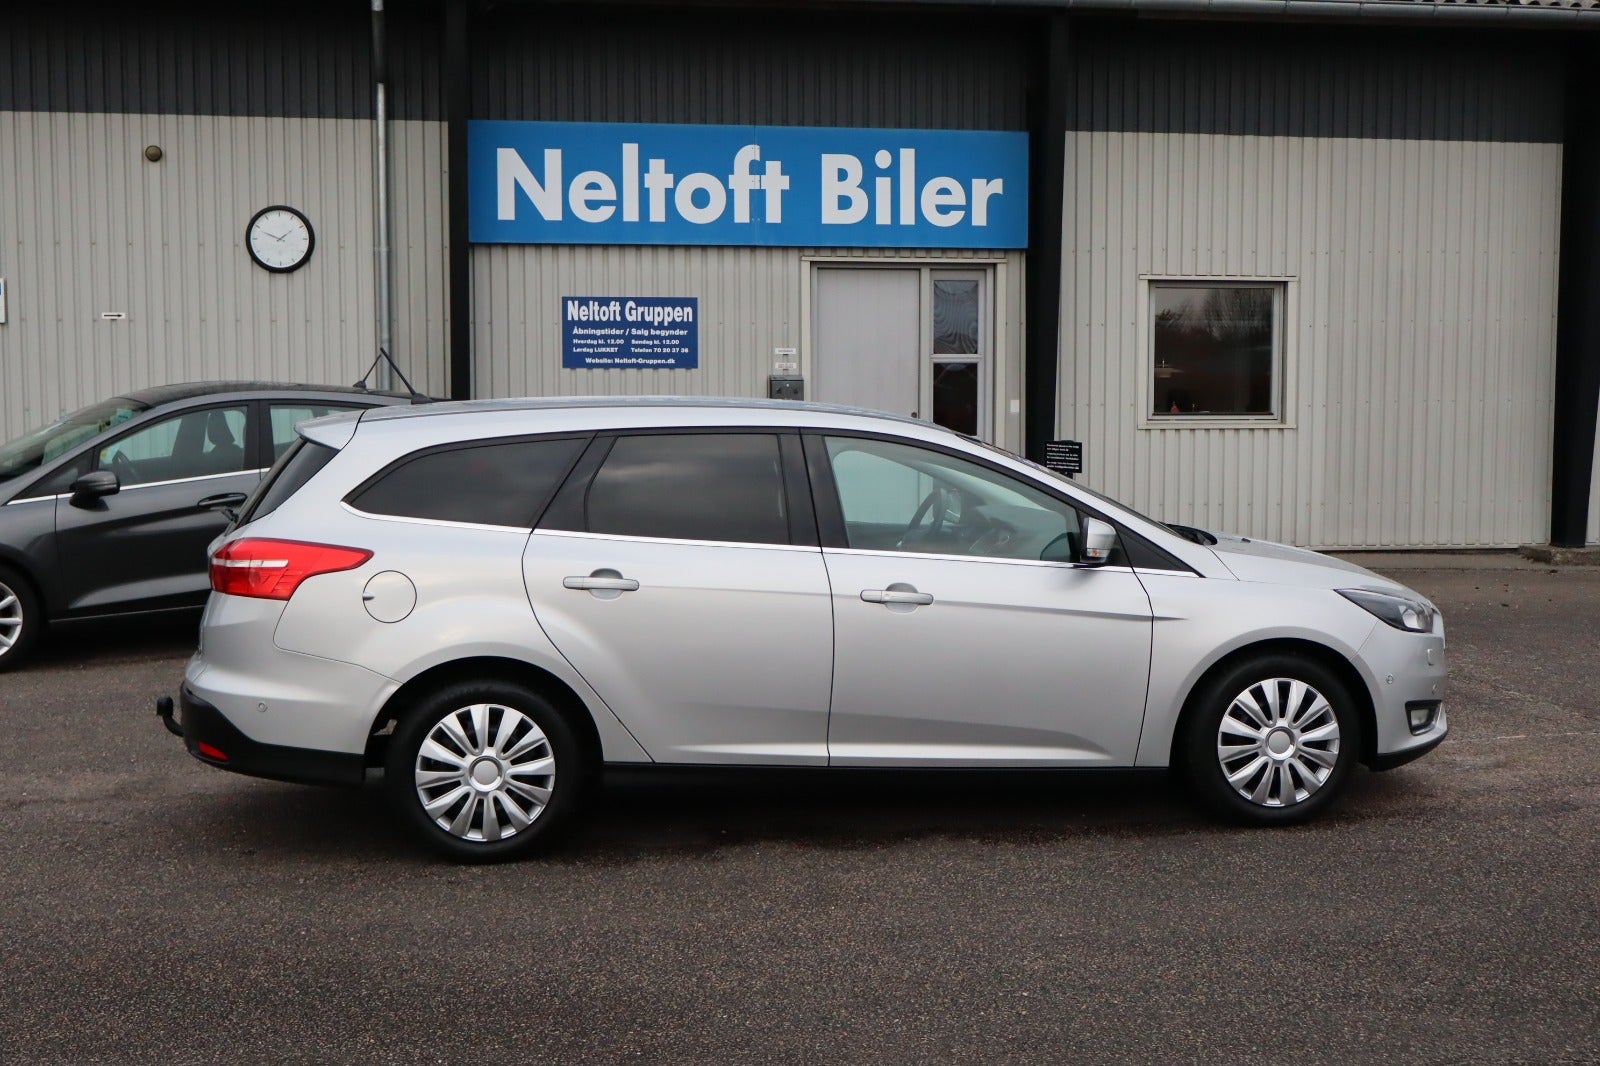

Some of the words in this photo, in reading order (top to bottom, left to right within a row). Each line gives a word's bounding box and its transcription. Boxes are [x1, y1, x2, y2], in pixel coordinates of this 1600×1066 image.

[496, 142, 790, 225] Neltoft
[821, 148, 1003, 227] Biler
[567, 300, 621, 322] Neltoft
[625, 301, 693, 326] Gruppen
[572, 326, 624, 336] Åbningstider
[625, 328, 629, 336] /
[631, 328, 649, 336] Salg
[650, 328, 688, 336] begynder
